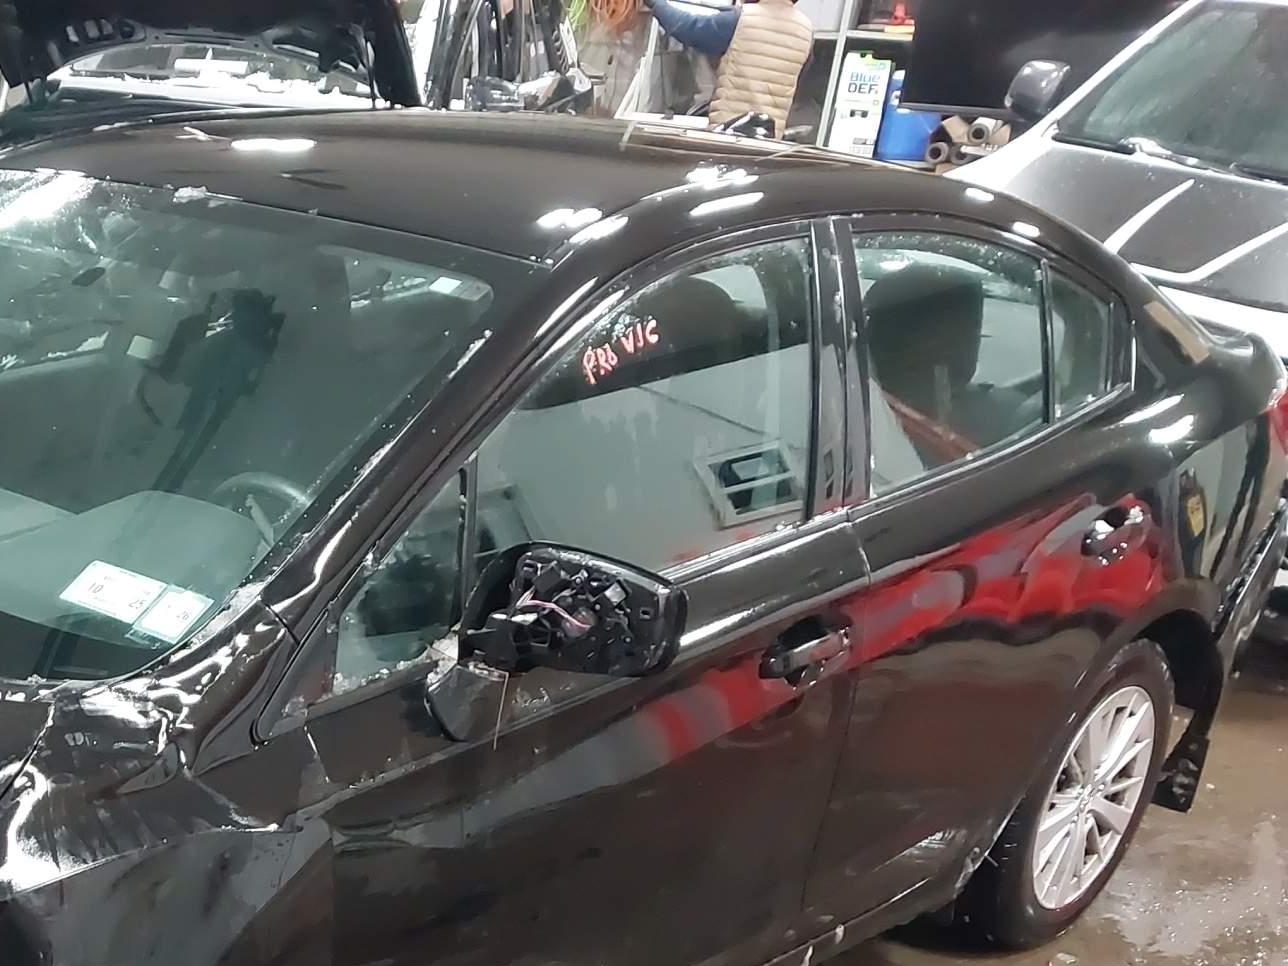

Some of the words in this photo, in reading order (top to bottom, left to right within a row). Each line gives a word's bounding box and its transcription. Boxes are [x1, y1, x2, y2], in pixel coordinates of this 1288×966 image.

[850, 71, 881, 83] Blue
[847, 82, 879, 95] DEF
[88, 582, 105, 594] 10
